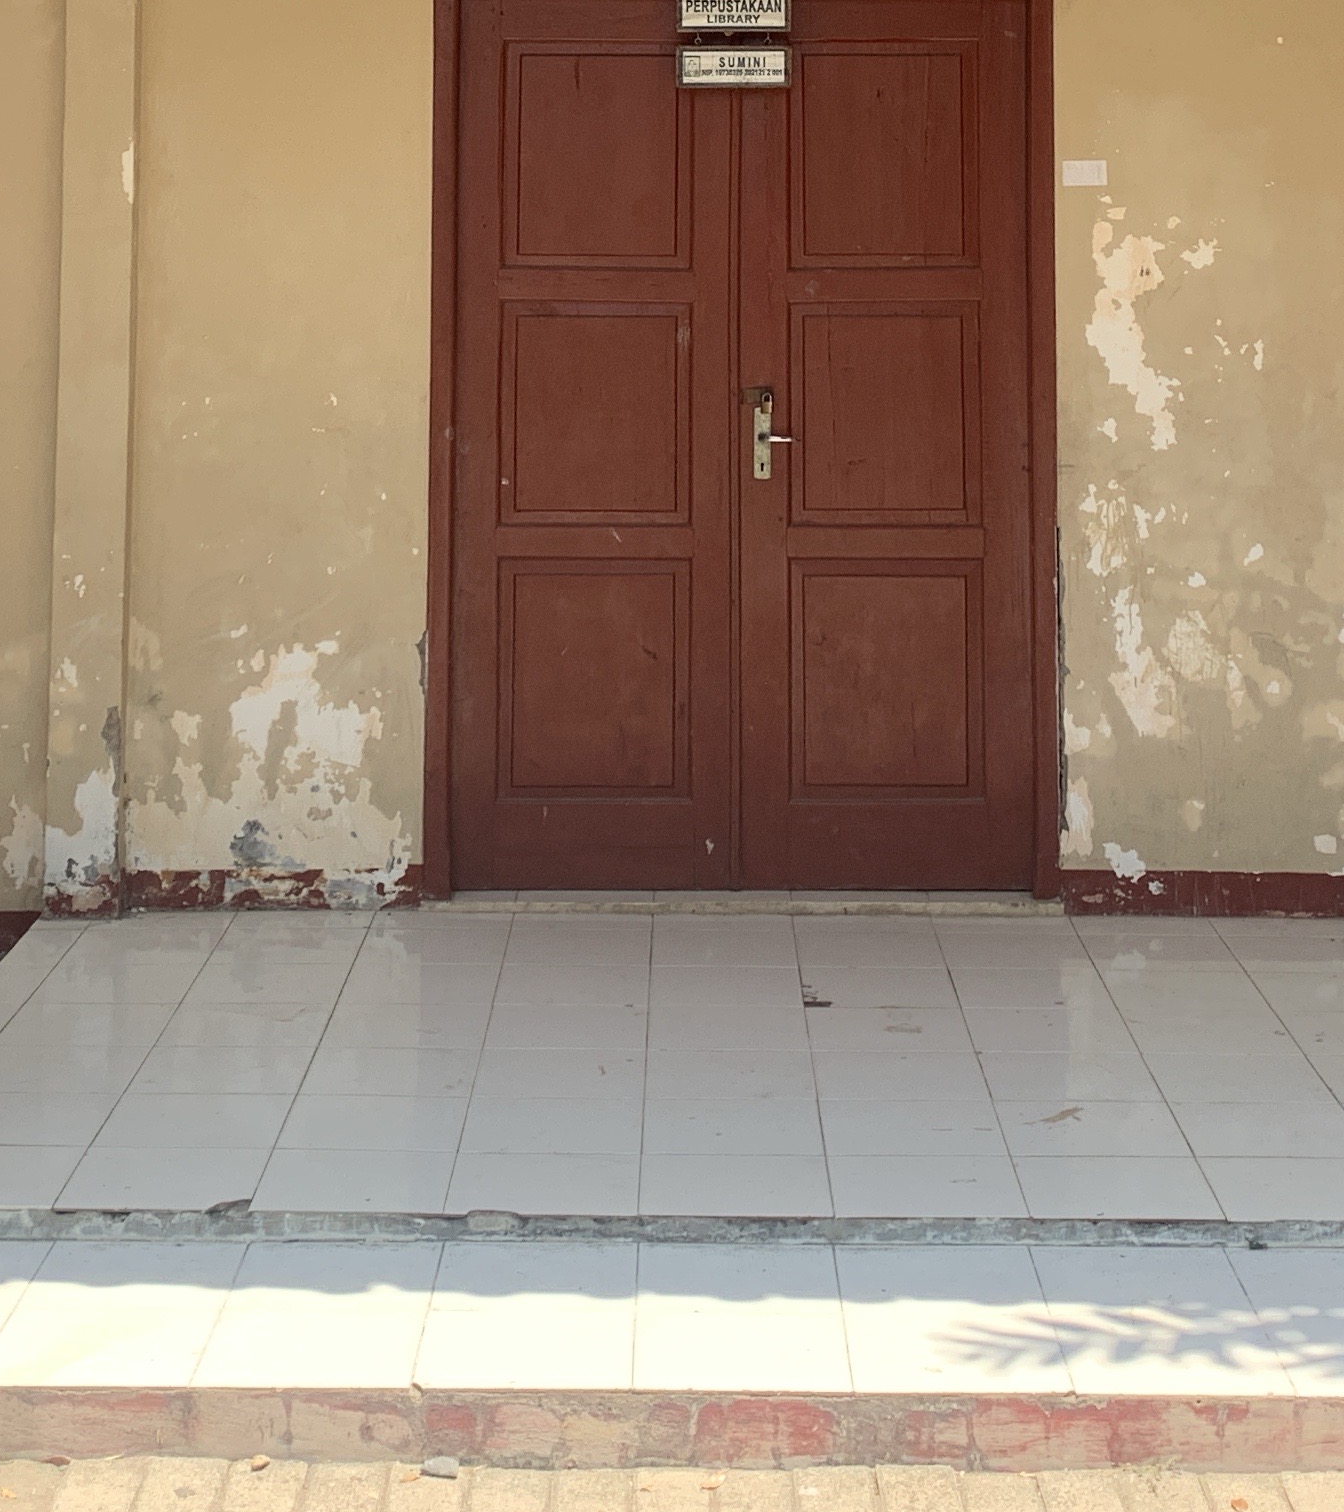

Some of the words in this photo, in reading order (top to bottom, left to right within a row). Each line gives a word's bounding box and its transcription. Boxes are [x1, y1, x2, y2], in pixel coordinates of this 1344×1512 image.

[685, 0, 782, 13] PERPUSTAKAAN
[706, 14, 760, 24] LIBRARY
[718, 56, 766, 68] SUMINI
